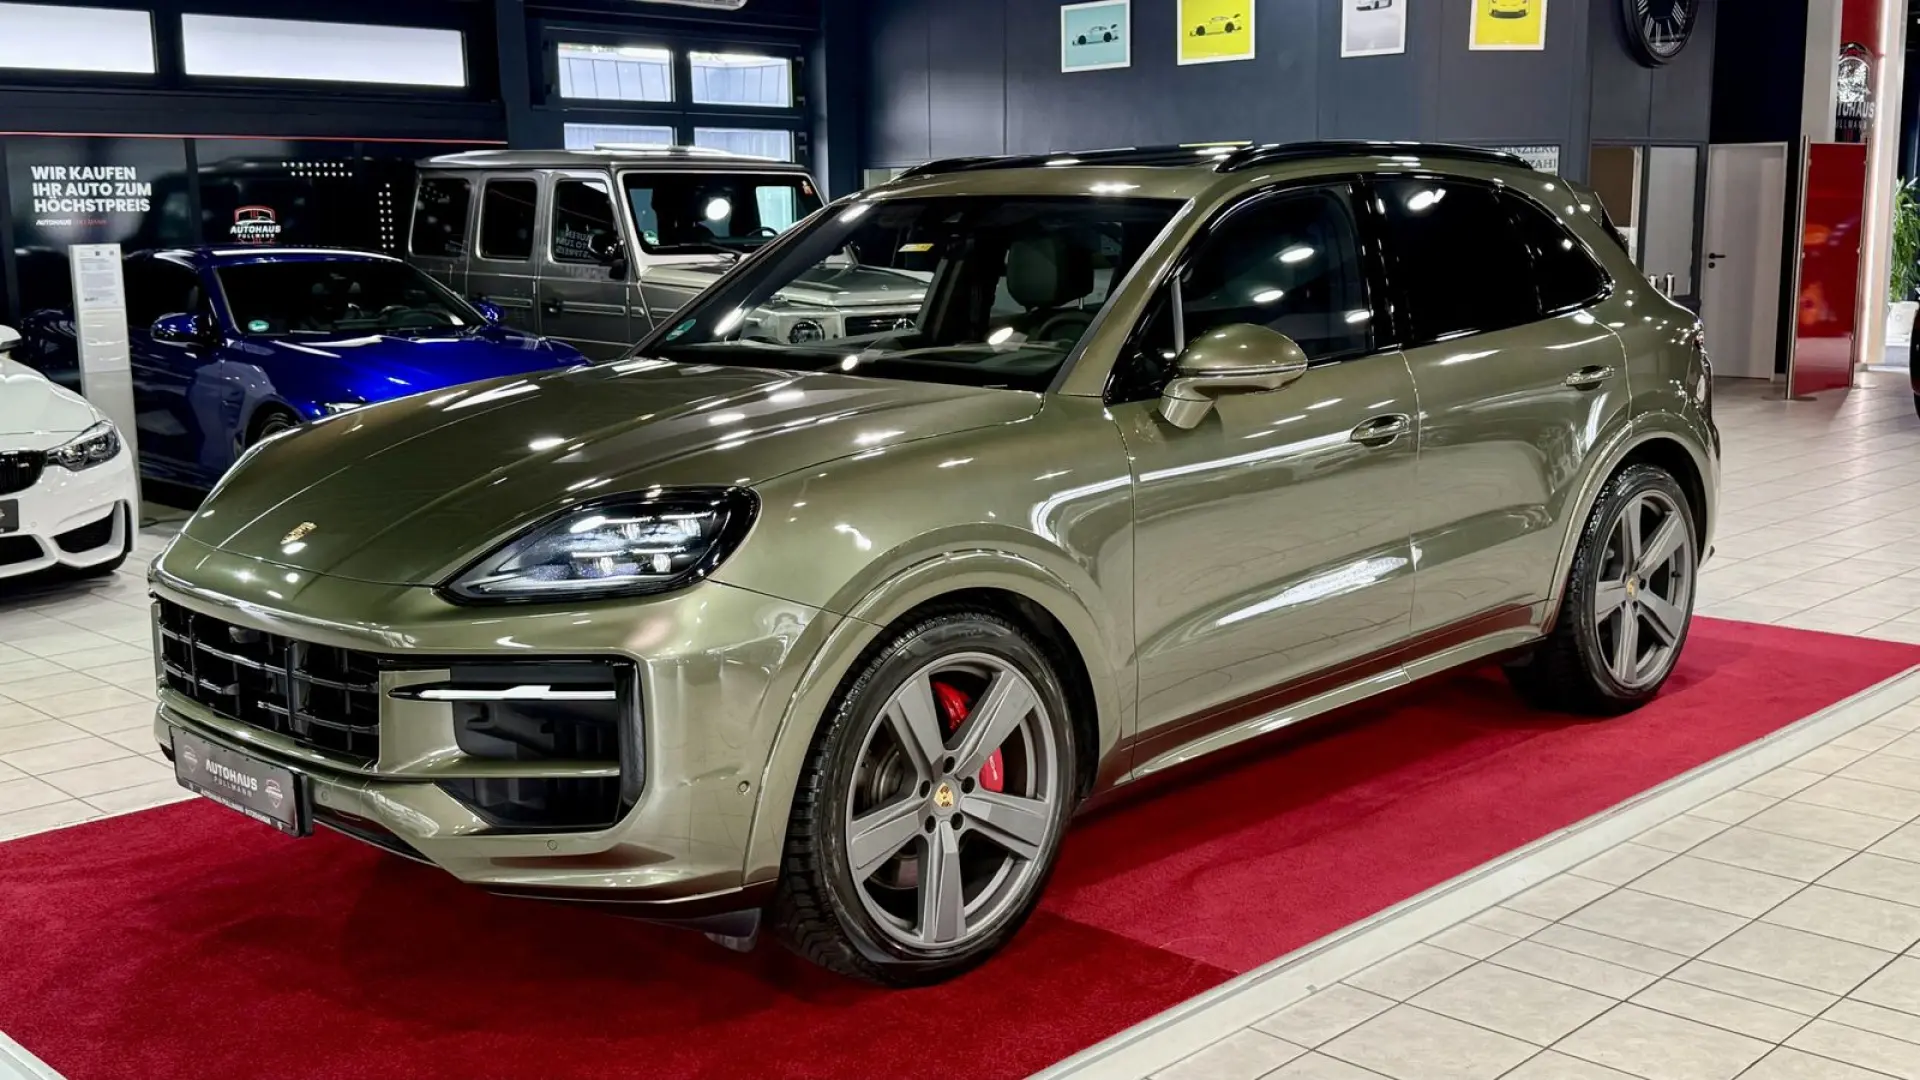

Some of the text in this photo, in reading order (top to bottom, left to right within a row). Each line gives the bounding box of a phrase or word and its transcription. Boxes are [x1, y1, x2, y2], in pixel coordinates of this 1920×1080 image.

[1837, 101, 1875, 118] TOHAUS
[30, 166, 137, 181] WIR KAUFEN
[32, 182, 152, 198] IHR AUTO ZUM
[34, 195, 151, 213] HÖCHSTPREIS
[230, 225, 282, 234] AUTOHAUS
[206, 759, 258, 792] AUTOHAUS
